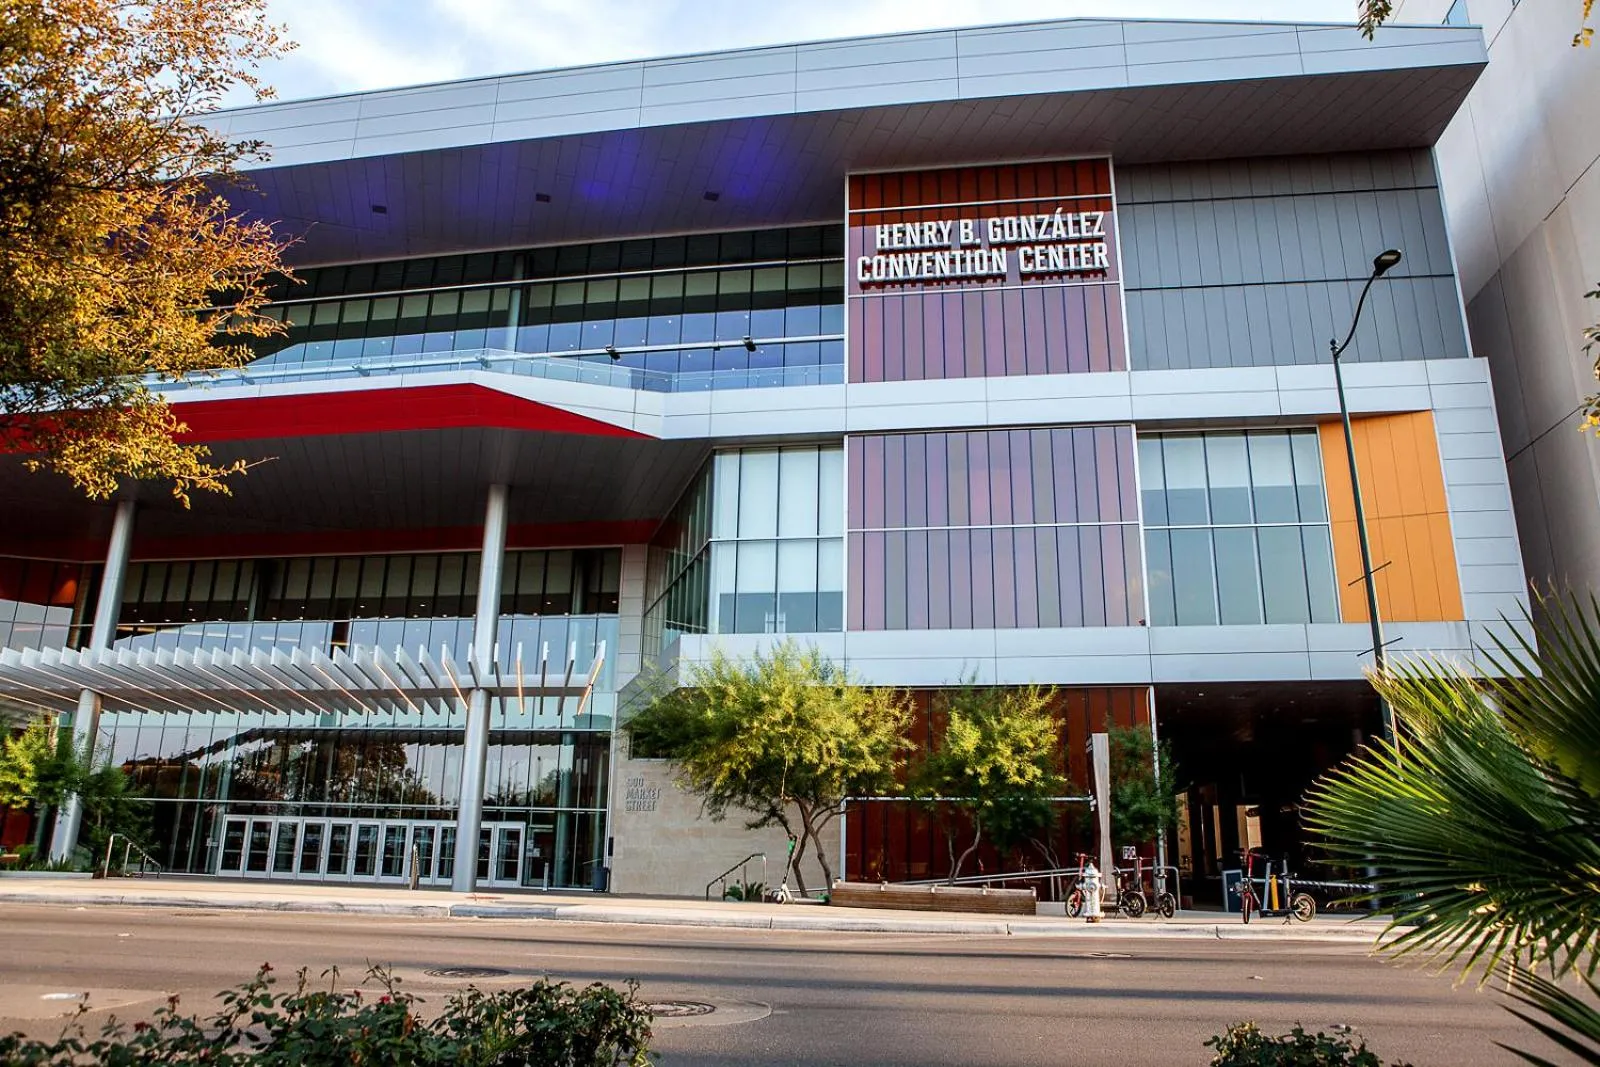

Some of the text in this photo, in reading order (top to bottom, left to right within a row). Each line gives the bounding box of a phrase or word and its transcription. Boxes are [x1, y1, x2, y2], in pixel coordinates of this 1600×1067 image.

[876, 207, 1106, 249] HENRY B. GONZÁLEZ
[857, 242, 1109, 282] CONVENTION CENTER
[625, 800, 657, 811] STREET
[626, 788, 661, 800] MARKET
